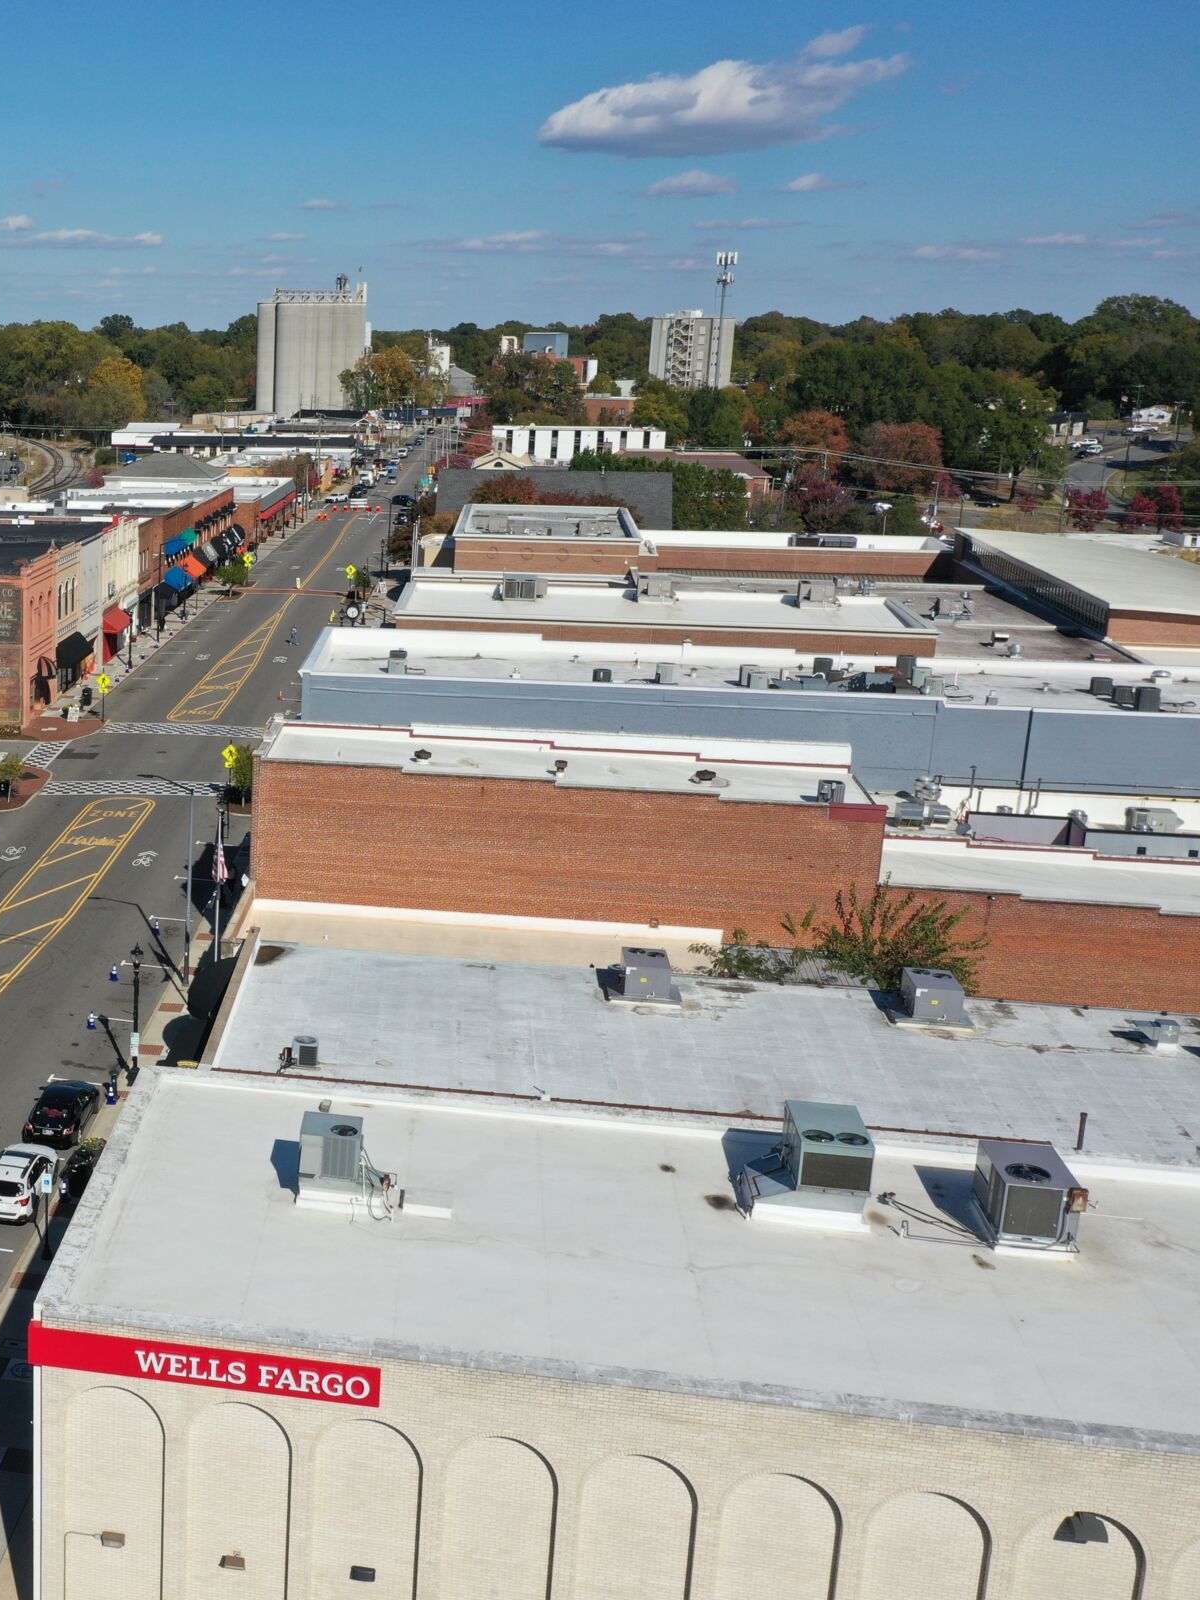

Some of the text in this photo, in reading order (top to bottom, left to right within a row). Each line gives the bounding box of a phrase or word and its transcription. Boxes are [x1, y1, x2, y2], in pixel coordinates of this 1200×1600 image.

[89, 809, 139, 818] ZONE
[134, 1350, 371, 1400] WELLS FARGO
